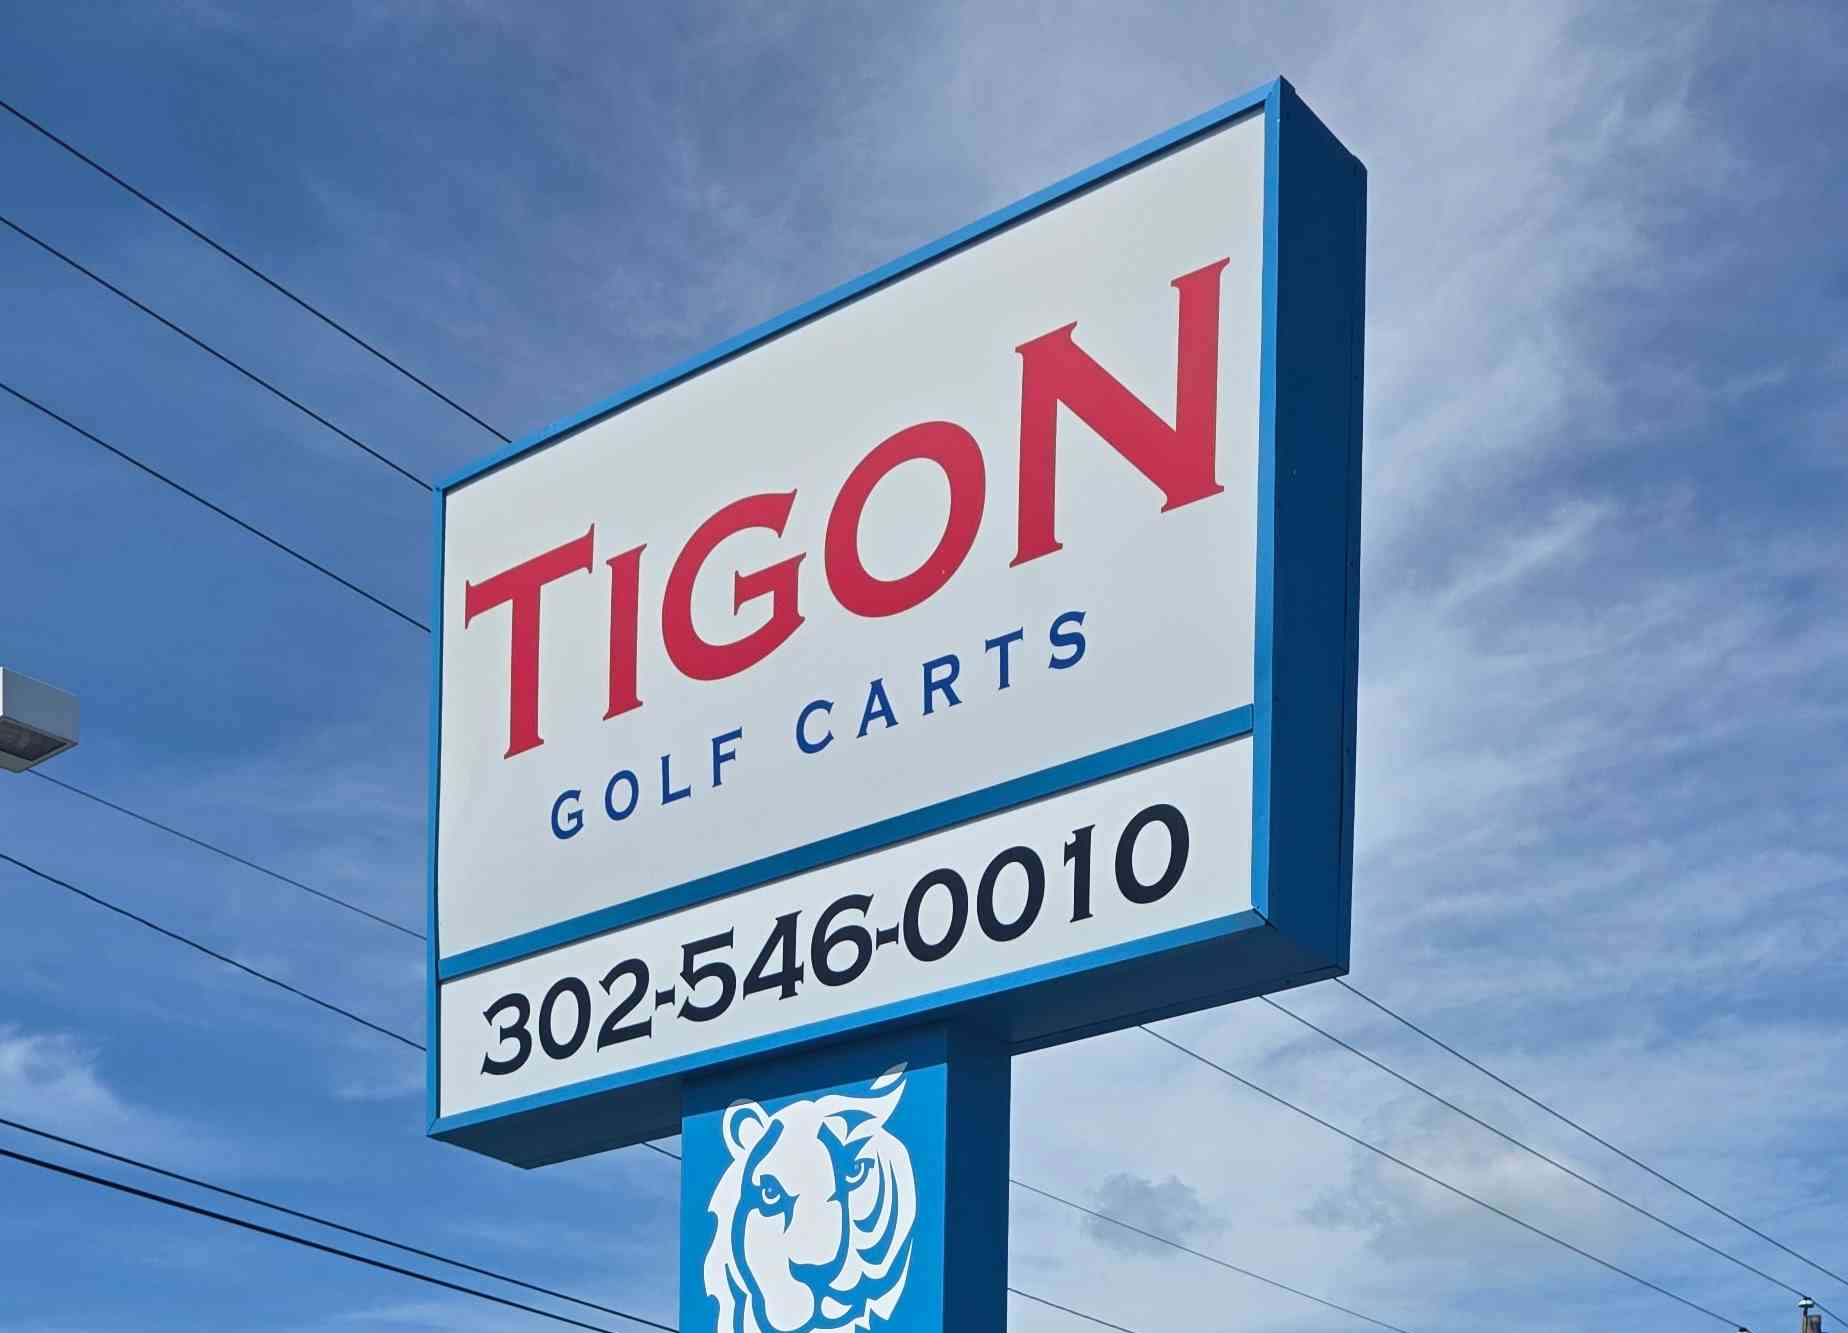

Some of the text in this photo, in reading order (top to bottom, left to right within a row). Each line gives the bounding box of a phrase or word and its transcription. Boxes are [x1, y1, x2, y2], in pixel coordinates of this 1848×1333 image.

[464, 257, 1231, 759] TIGON
[550, 609, 1089, 841] GOLF CARTS
[480, 803, 1191, 1077] 302-546-0010
